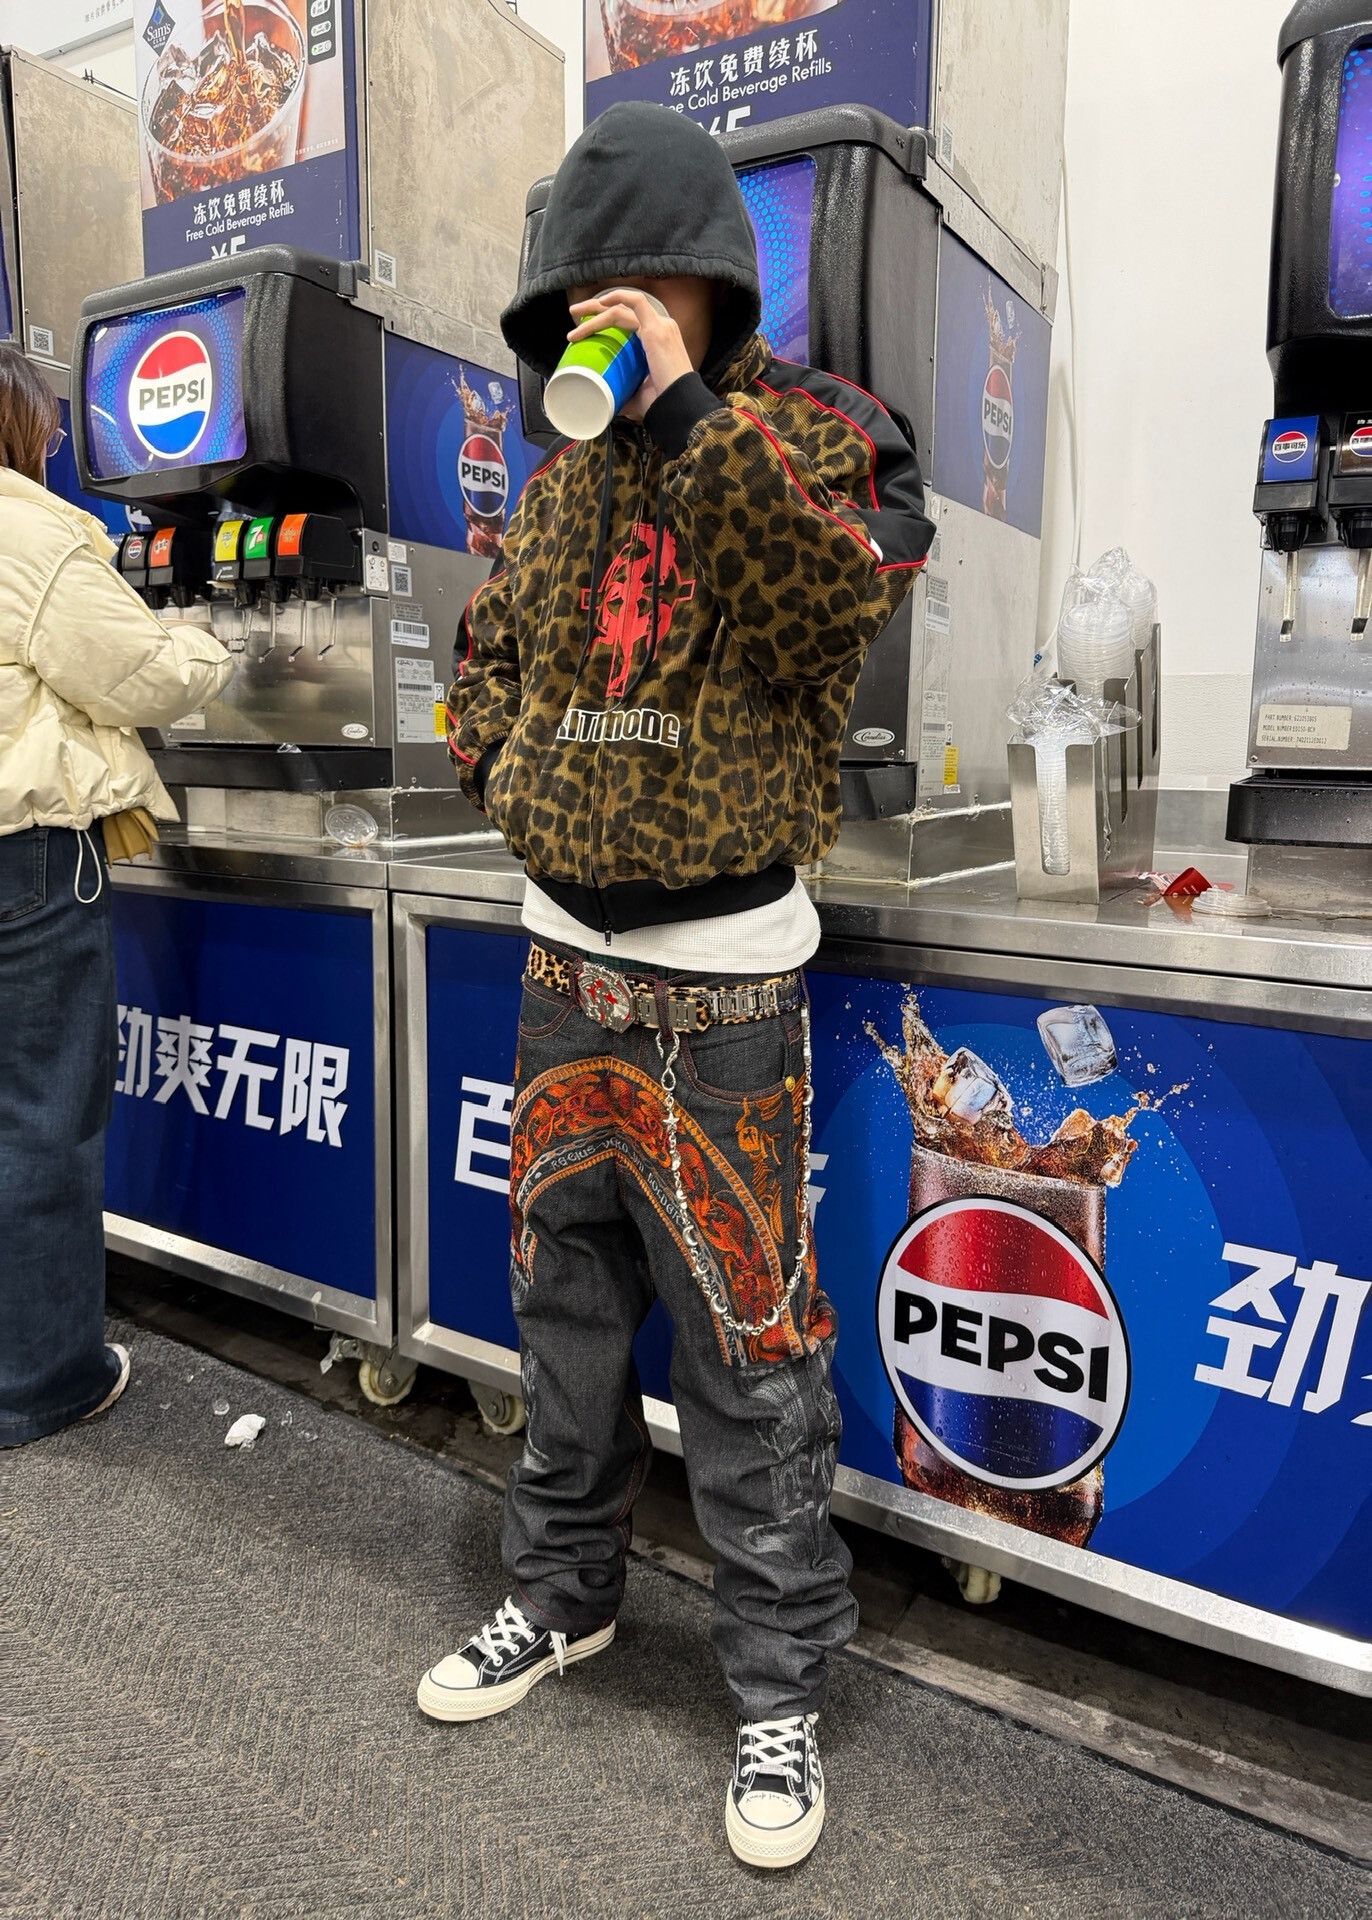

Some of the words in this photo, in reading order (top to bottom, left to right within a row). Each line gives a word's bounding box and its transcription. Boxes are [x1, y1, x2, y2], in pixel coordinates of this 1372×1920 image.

[146, 23, 172, 41] Sam's
[670, 29, 818, 97] 冻饮免费续杯
[688, 86, 719, 110] Cold
[723, 73, 787, 102] Beverage
[792, 57, 832, 83] Refills
[186, 229, 204, 242] Free
[205, 220, 225, 236] Cold
[226, 212, 267, 231] Beverage
[269, 202, 295, 219] Refills
[193, 179, 285, 225] 冻饮免费续杯
[139, 377, 206, 411] PEPSI
[984, 398, 1012, 436] PEPSI
[1274, 440, 1307, 451] 百事可乐
[461, 461, 506, 491] PEPSI
[114, 1004, 350, 1148] 劲爽无限
[893, 1289, 1110, 1403] PEPSI
[1194, 1242, 1372, 1427] 劲
